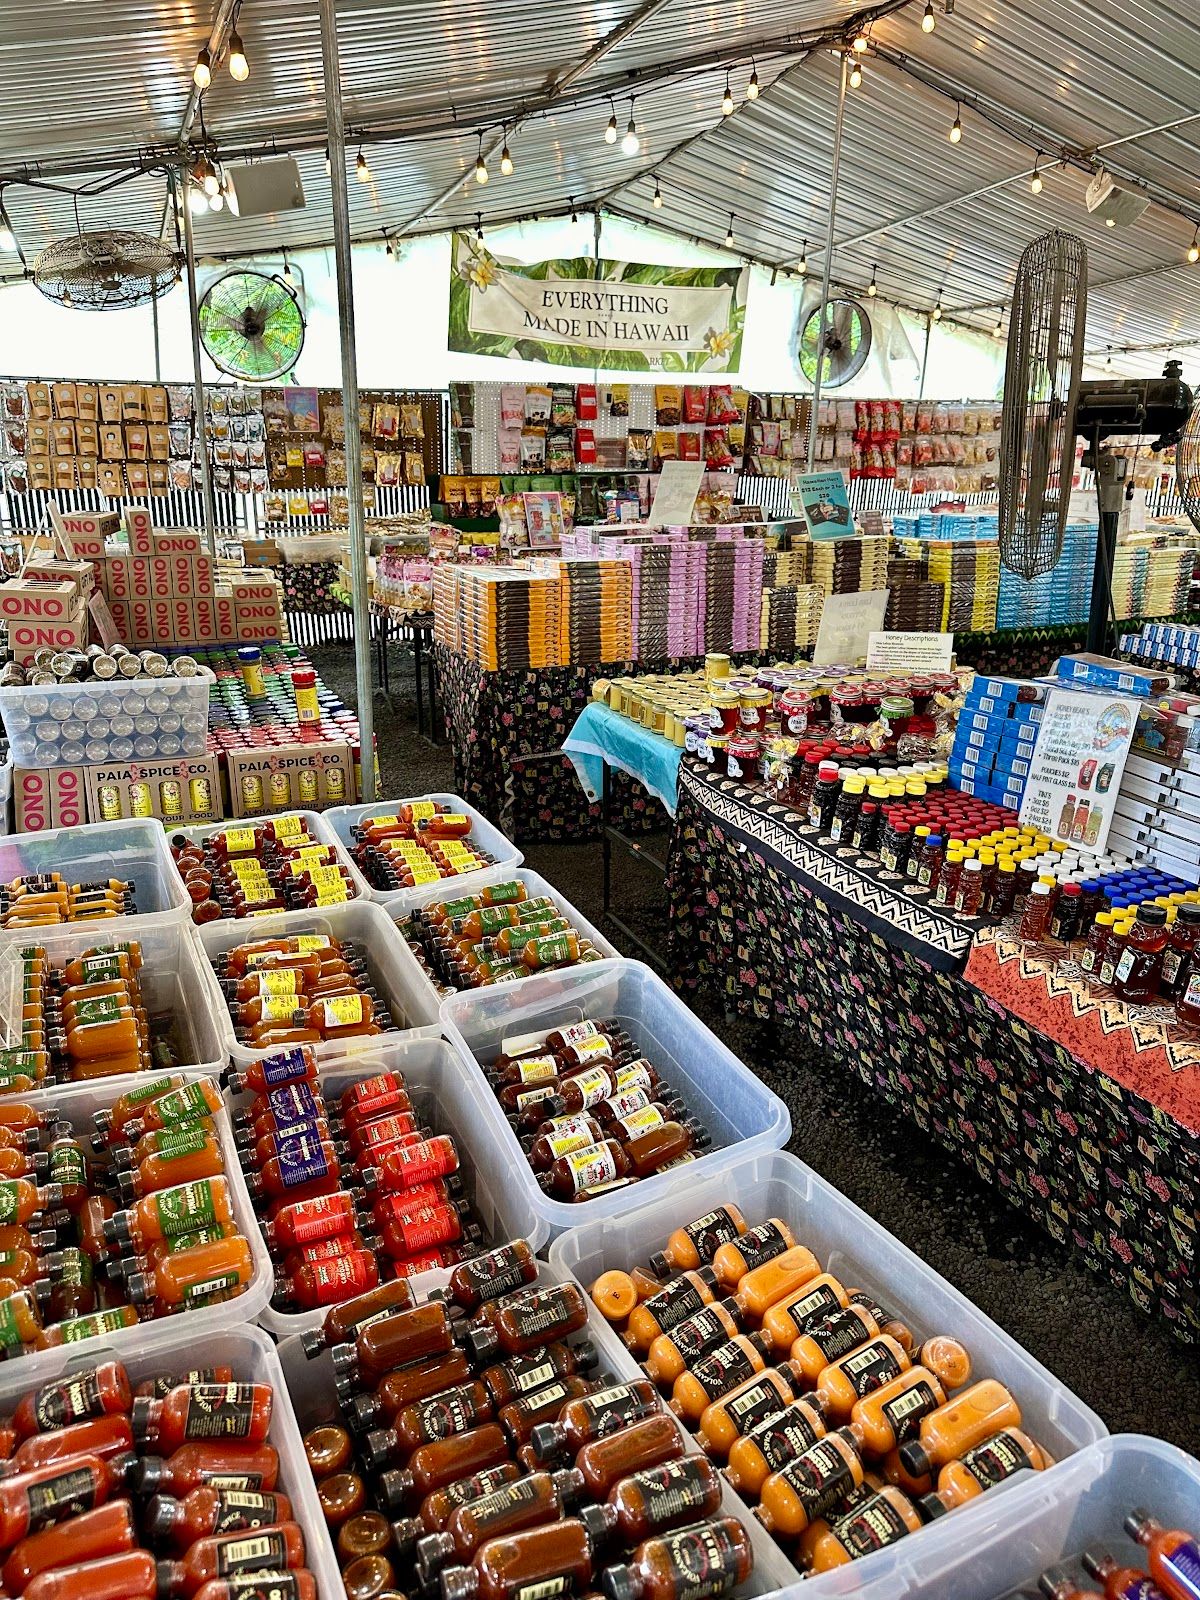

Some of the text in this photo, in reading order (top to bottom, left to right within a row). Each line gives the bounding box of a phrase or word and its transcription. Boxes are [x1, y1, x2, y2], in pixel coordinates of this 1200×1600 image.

[541, 290, 669, 314] EVERYTHING
[523, 311, 689, 341] MADE IN HAWAII
[134, 514, 150, 553] ONO
[158, 539, 197, 551] ONO
[60, 542, 101, 554] NO
[111, 560, 126, 597] ONO
[133, 559, 147, 596] ONO
[154, 558, 168, 596] ONO
[176, 558, 190, 594] ONO
[197, 557, 211, 594] ONO
[2, 597, 63, 616] ONO
[236, 587, 273, 599] ONO
[134, 602, 149, 639] ONO
[155, 602, 170, 638] ONO
[176, 601, 190, 637] ONO
[197, 600, 212, 636] ONO
[218, 599, 232, 636] ONO
[239, 605, 276, 618] ONO
[15, 628, 75, 646] ONO
[240, 626, 278, 639] ONO
[904, 635, 939, 643] Descriptions
[97, 764, 210, 781] PAIA SPICE CO.
[239, 754, 343, 772] PAIA SPICE CO.
[23, 775, 44, 830] ONO
[57, 772, 79, 827] ONO
[295, 803, 319, 811] YOUR
[50, 1166, 81, 1177] PINEAPPLE
[691, 1229, 711, 1249] SPICE
[336, 1257, 347, 1284] CAROLINA
[691, 1314, 711, 1341] FRESNO
[853, 1372, 874, 1394] SPICE
[67, 1382, 88, 1416] FRESNO
[421, 1401, 441, 1419] SPICE
[453, 1414, 465, 1431] OLD
[593, 1409, 617, 1432] SPICE
[757, 1429, 779, 1452] SPICE
[805, 1446, 832, 1480] FRESNO
[815, 1445, 834, 1471] COCONUT
[788, 1468, 821, 1499] VOLCANO
[863, 1507, 892, 1546] FRESNO
[872, 1506, 894, 1536] COCONUT
[674, 1549, 701, 1585] VOLCANO
[706, 1547, 722, 1570] OLD
